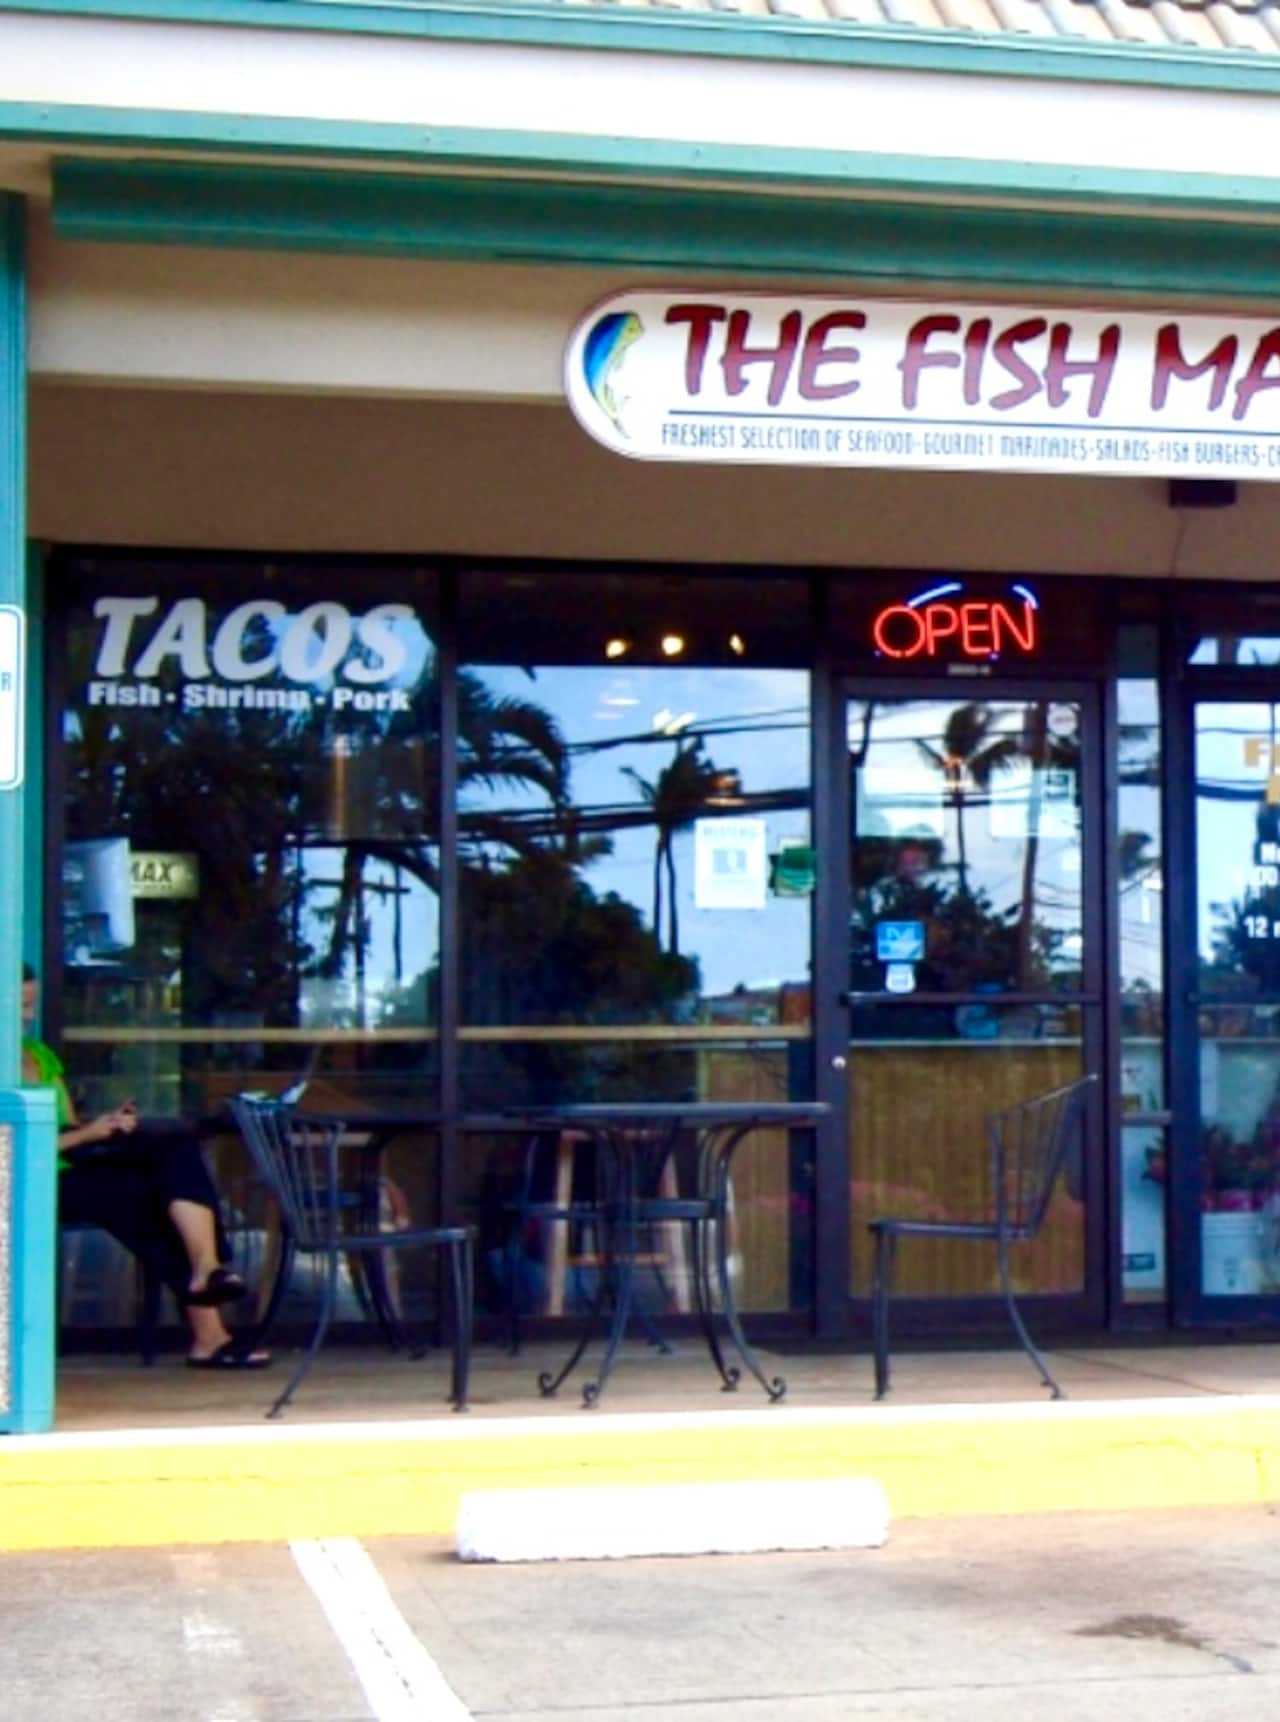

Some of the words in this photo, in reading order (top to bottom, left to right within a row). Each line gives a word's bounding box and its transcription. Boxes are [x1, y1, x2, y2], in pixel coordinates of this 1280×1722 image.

[664, 302, 867, 407] THE
[896, 311, 1122, 418] FISH
[661, 423, 735, 449] FRESHEST
[740, 424, 820, 451] SELECTION
[826, 428, 843, 452] OF
[92, 595, 416, 685] TACOS
[873, 602, 1036, 658] OPEN
[88, 682, 161, 706] Fish
[183, 684, 312, 711] Shrimp
[332, 687, 412, 711] Pork
[1245, 917, 1267, 937] 12
